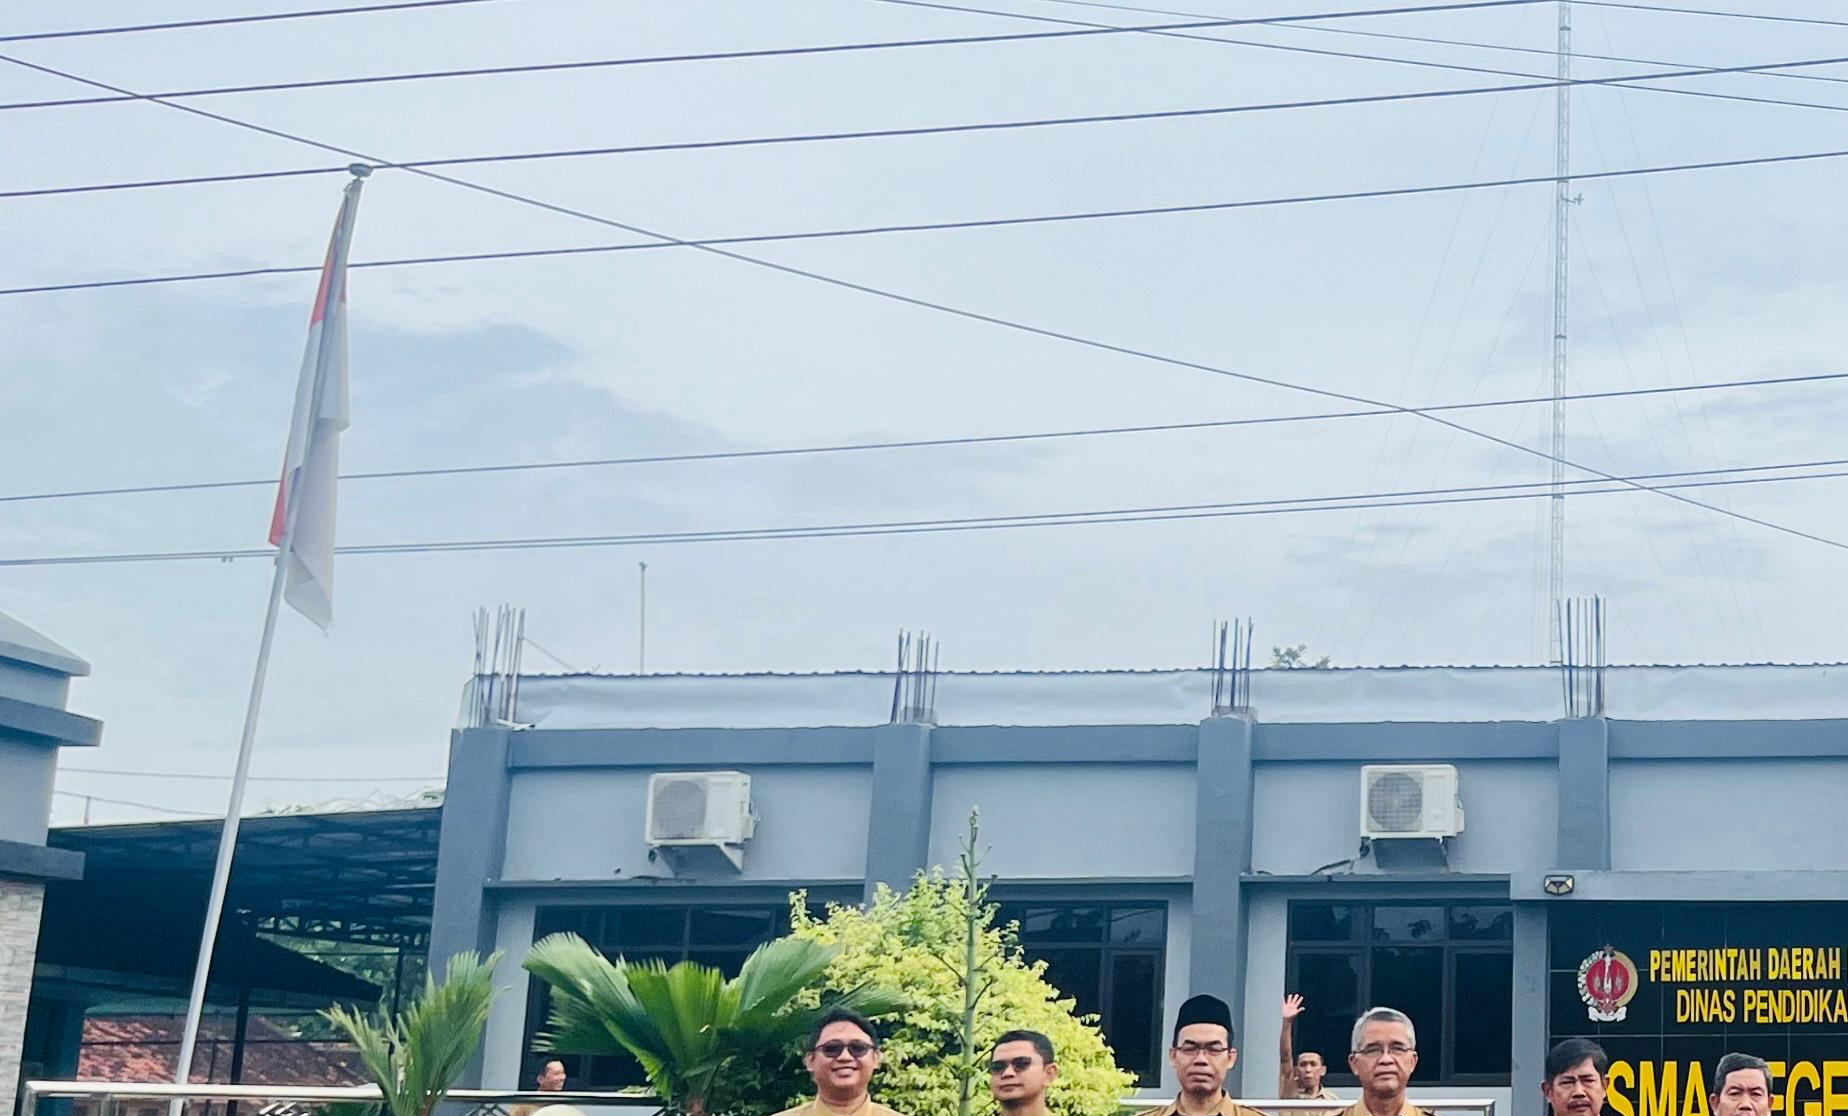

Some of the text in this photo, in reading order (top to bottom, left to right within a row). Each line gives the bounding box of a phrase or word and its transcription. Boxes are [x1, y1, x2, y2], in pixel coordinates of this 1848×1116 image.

[1650, 949, 1761, 982] PEMERINTAH
[1767, 947, 1841, 980] DAERAH
[1676, 988, 1736, 1023] DINAS
